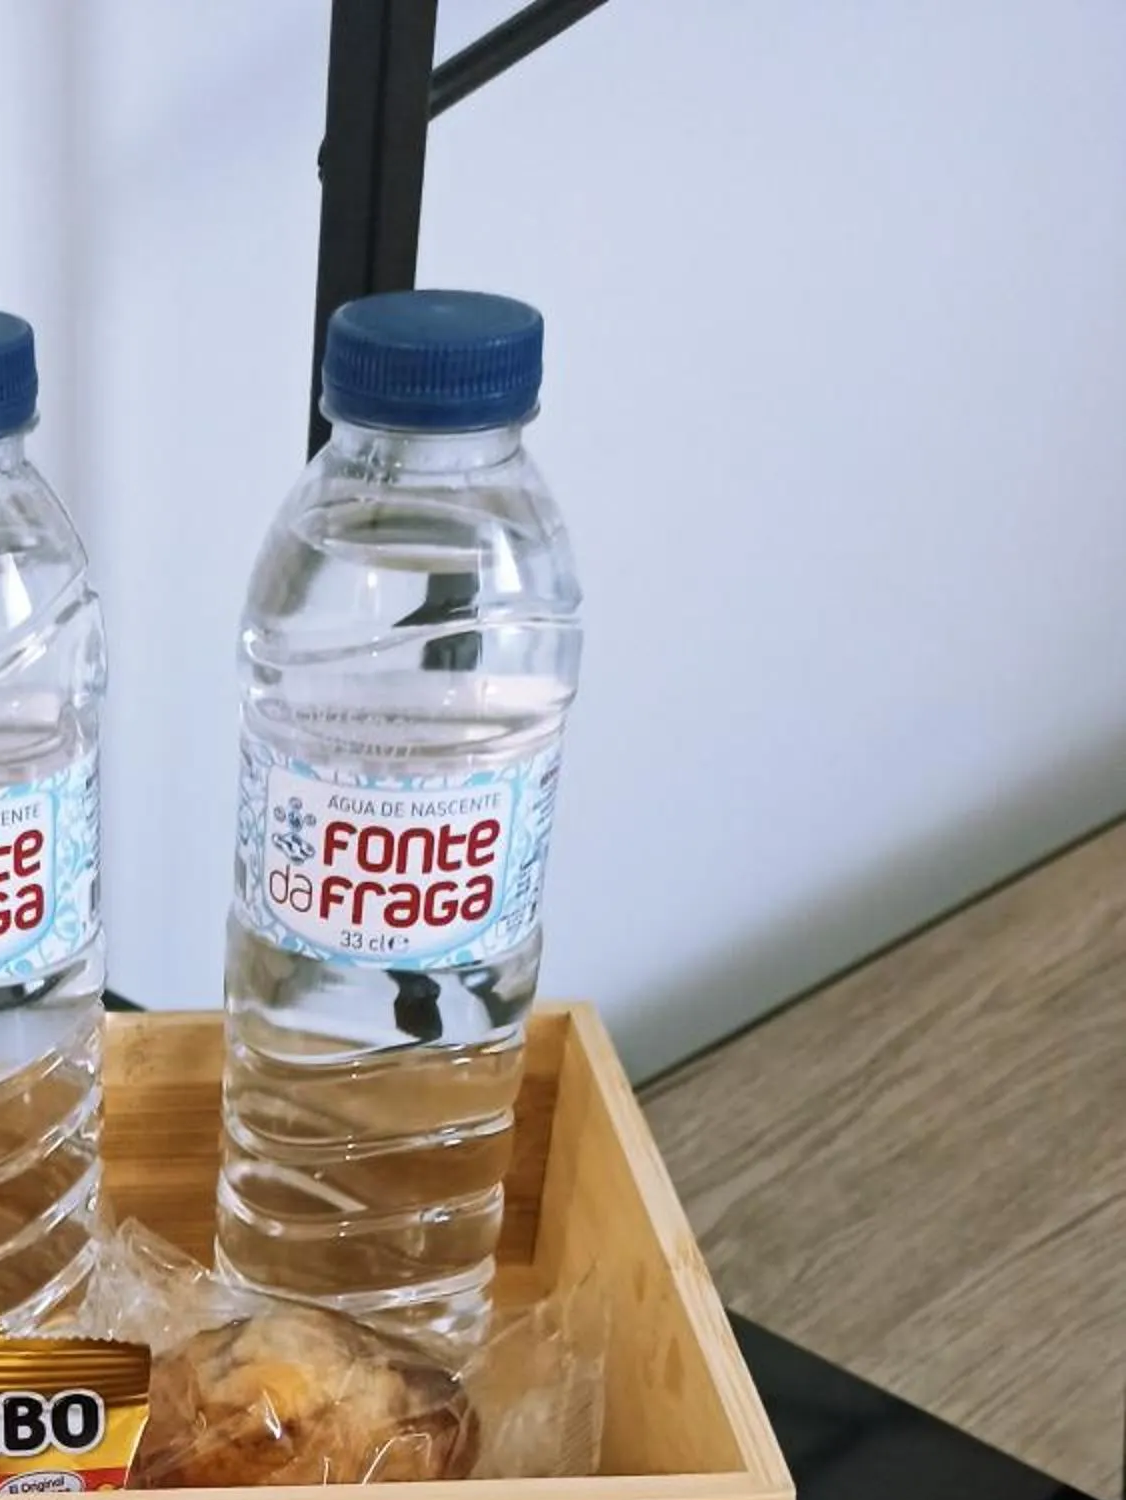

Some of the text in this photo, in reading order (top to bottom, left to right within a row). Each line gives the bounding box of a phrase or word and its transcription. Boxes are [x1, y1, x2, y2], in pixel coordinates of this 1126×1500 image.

[382, 801, 405, 818] DE
[412, 792, 501, 817] NASCENTE
[269, 865, 313, 913] da
[341, 930, 364, 950] 33
